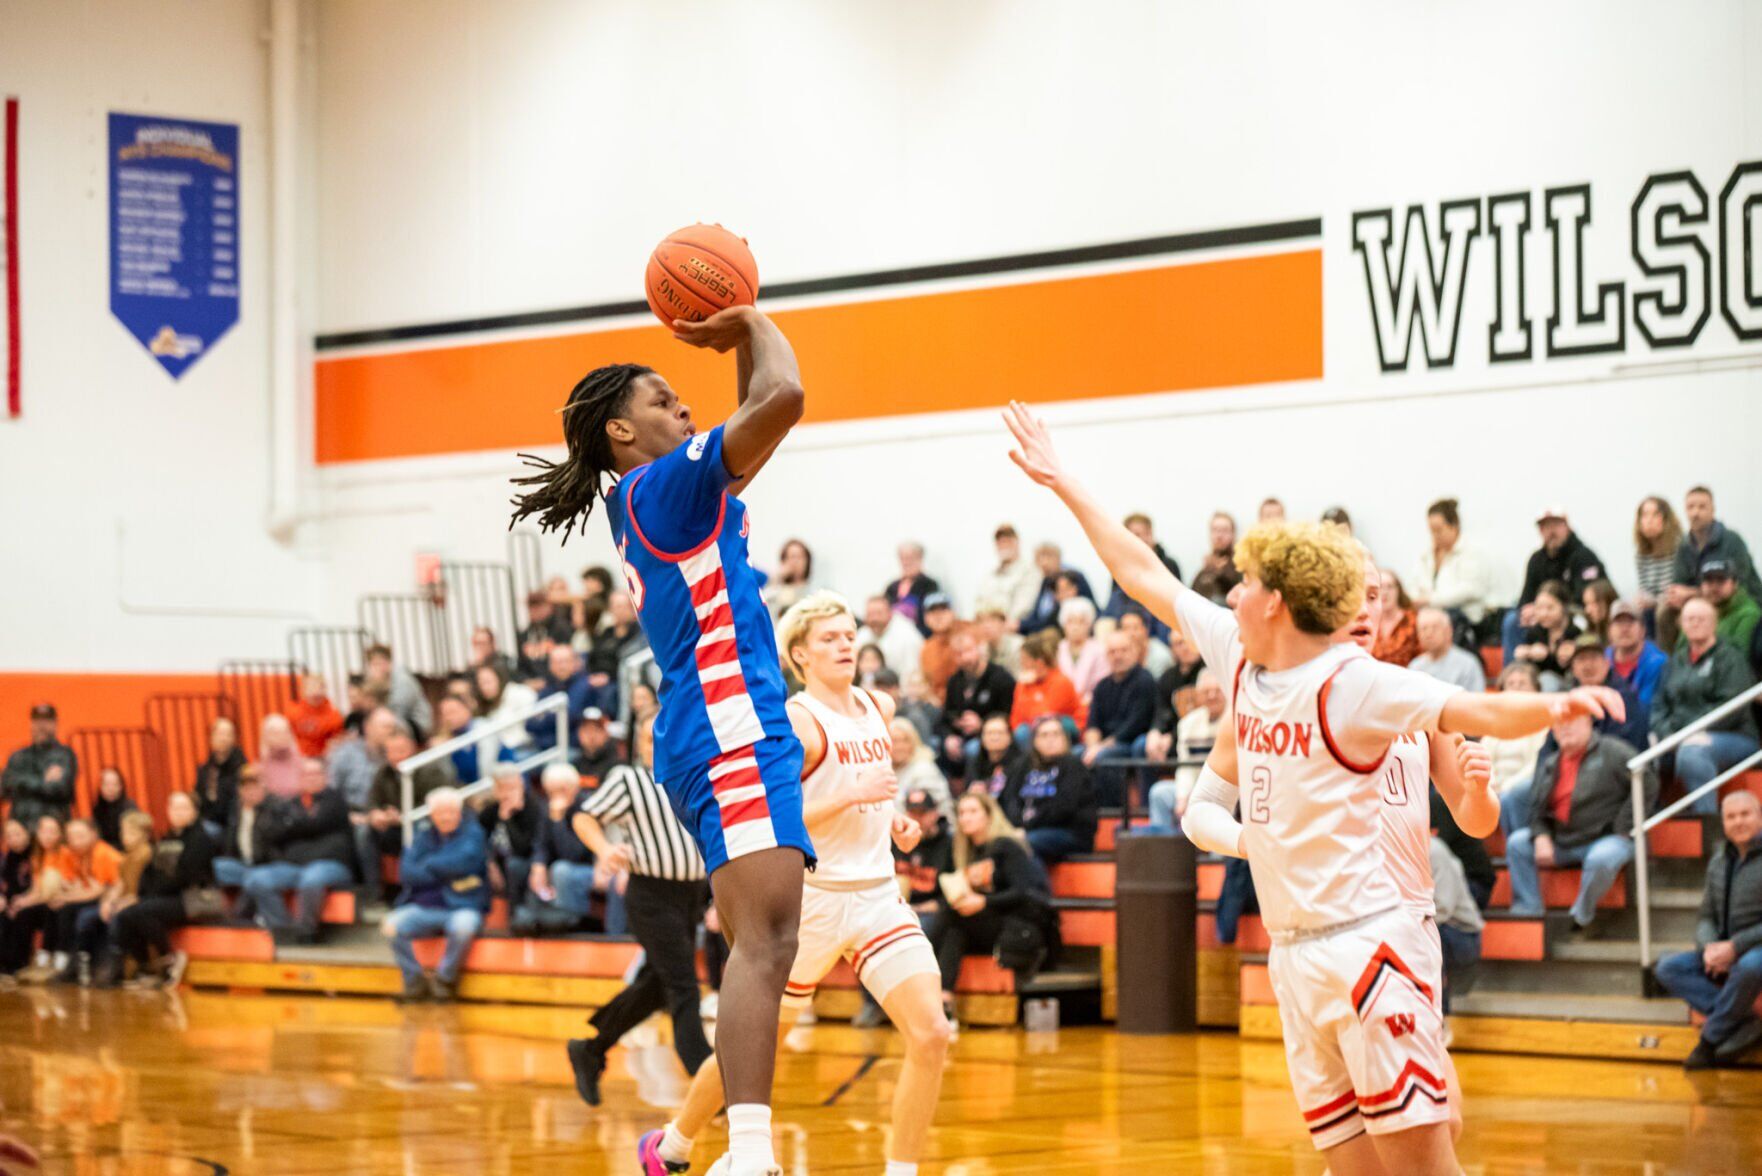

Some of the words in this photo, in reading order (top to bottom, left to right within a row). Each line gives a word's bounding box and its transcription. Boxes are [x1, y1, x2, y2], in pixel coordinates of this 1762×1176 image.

[660, 277, 708, 321] ALDING
[678, 263, 737, 304] LEGACY
[1250, 765, 1272, 825] 2
